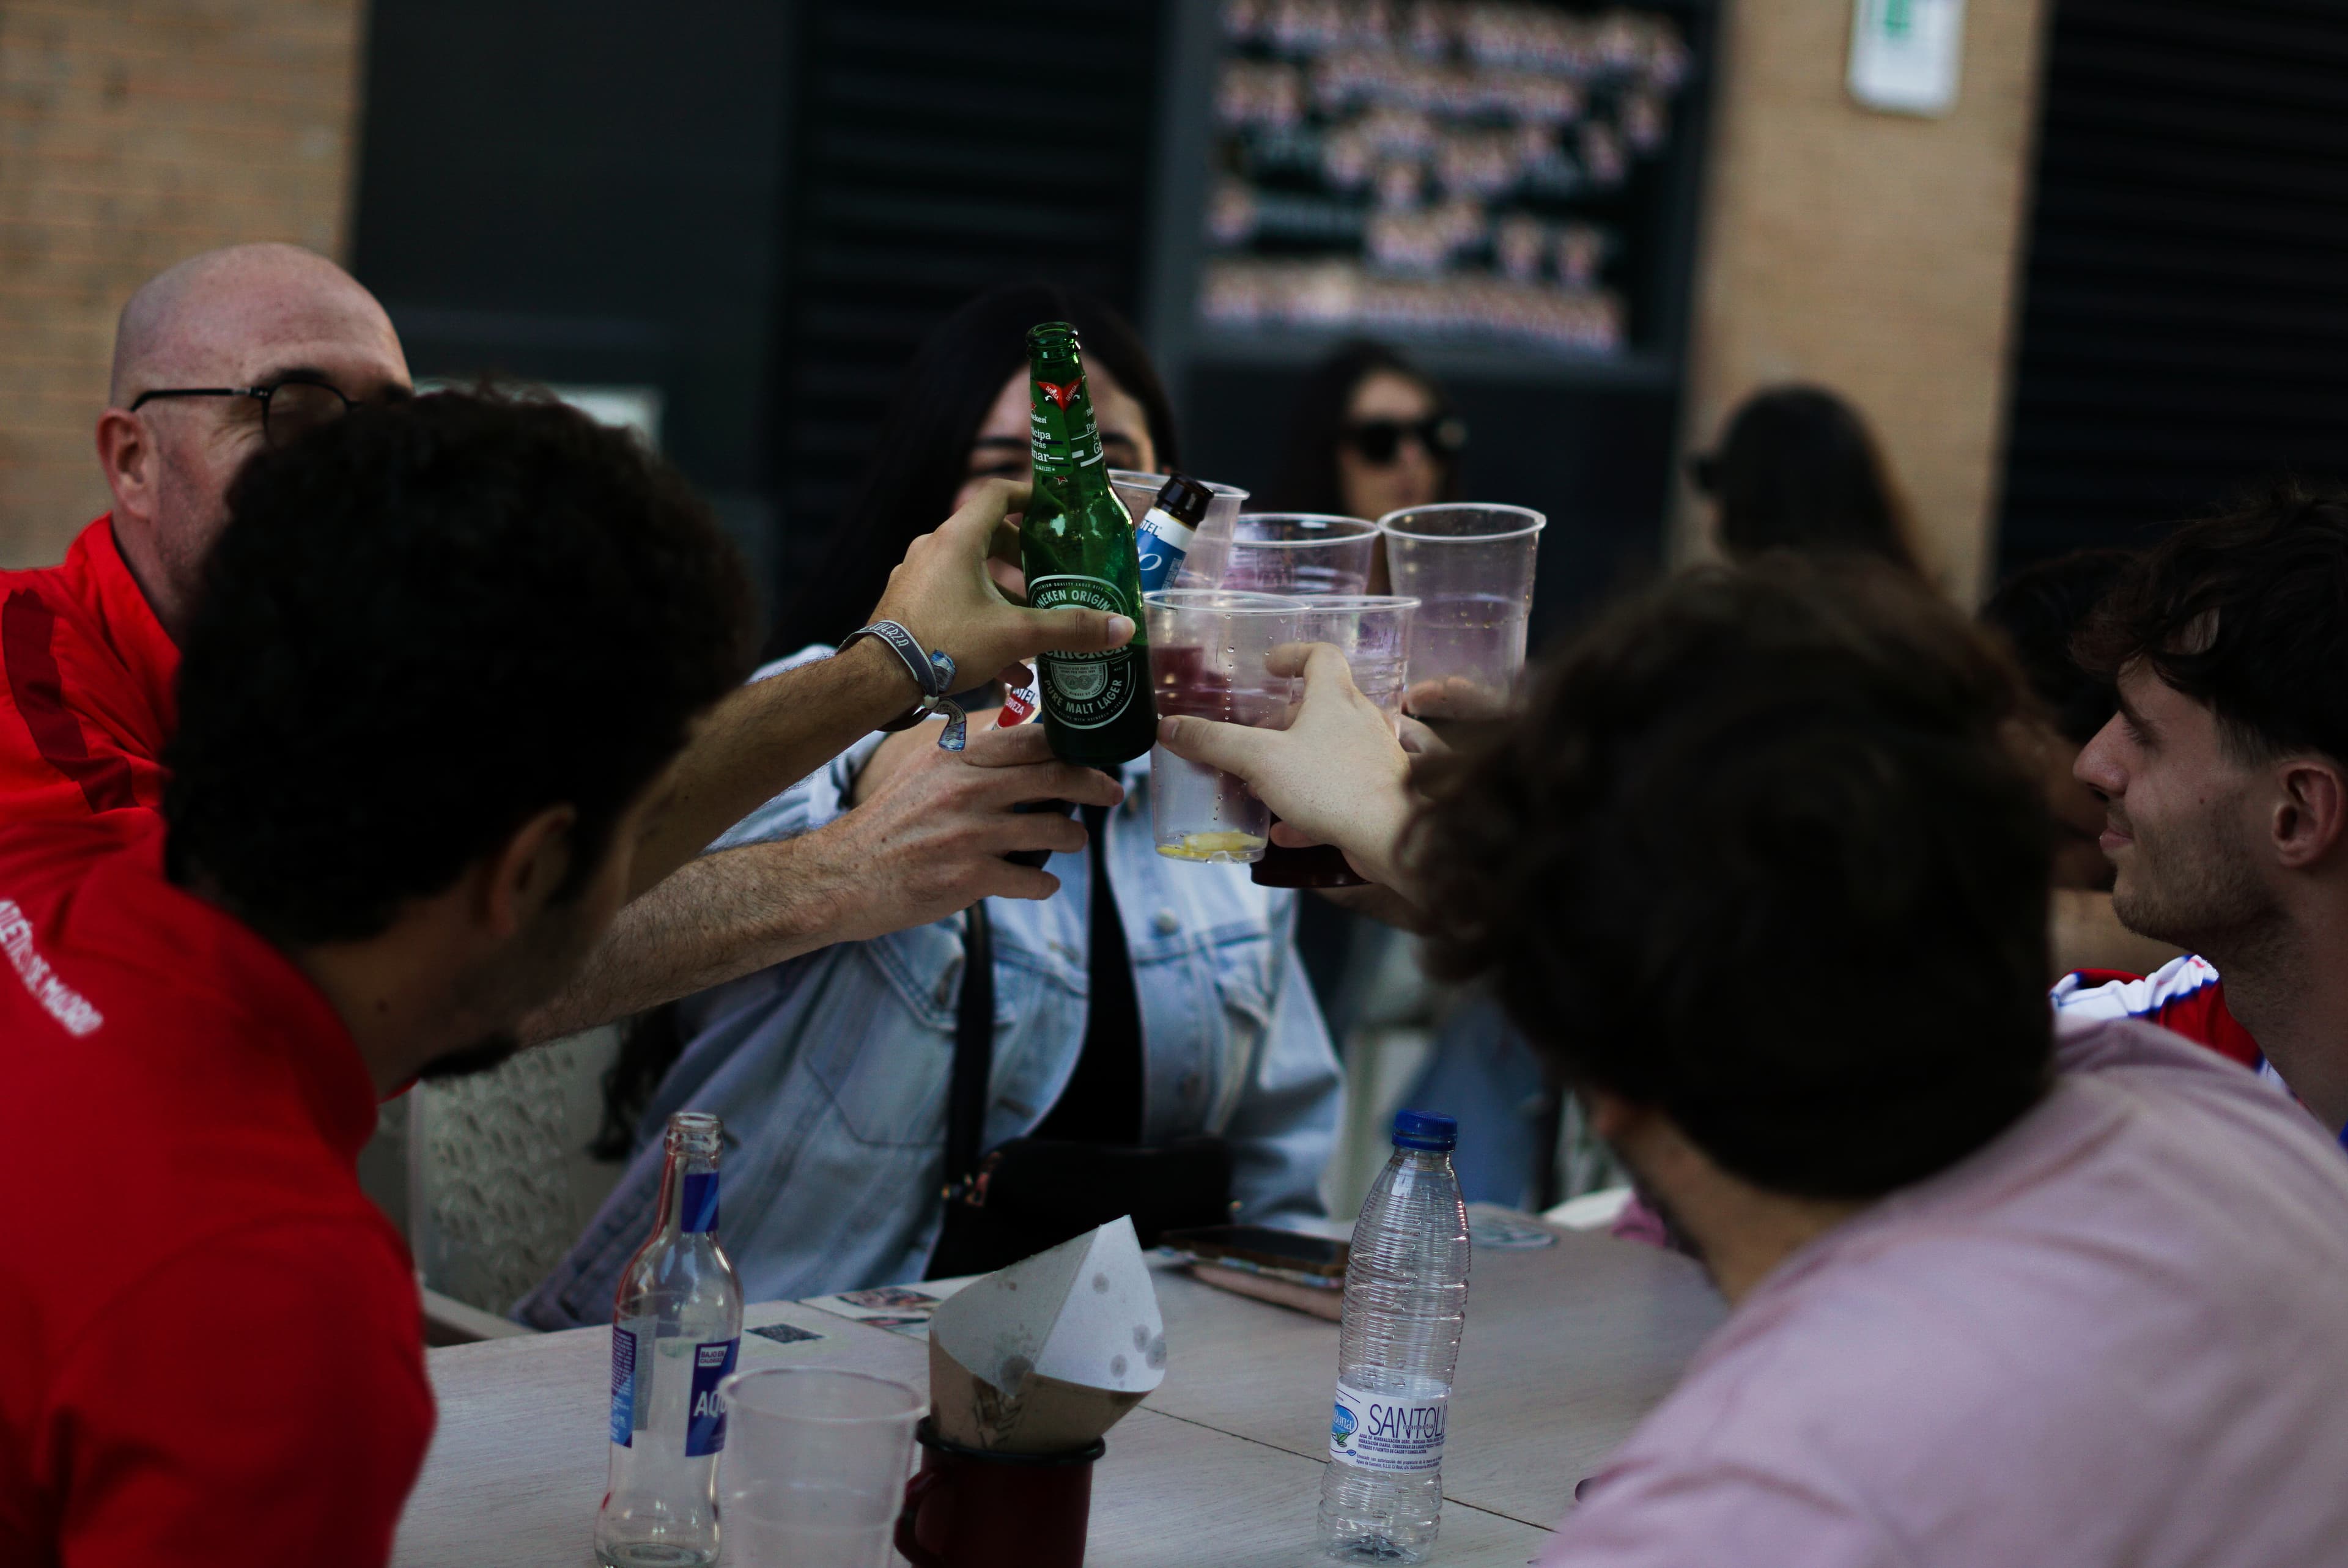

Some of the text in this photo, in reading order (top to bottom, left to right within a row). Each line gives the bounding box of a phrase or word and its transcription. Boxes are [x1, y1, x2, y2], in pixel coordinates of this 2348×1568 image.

[1036, 589, 1114, 612] INEKEN ORIGIN
[1044, 679, 1063, 707] PURE
[1066, 701, 1093, 714] MALT
[1097, 679, 1123, 710] LAGER
